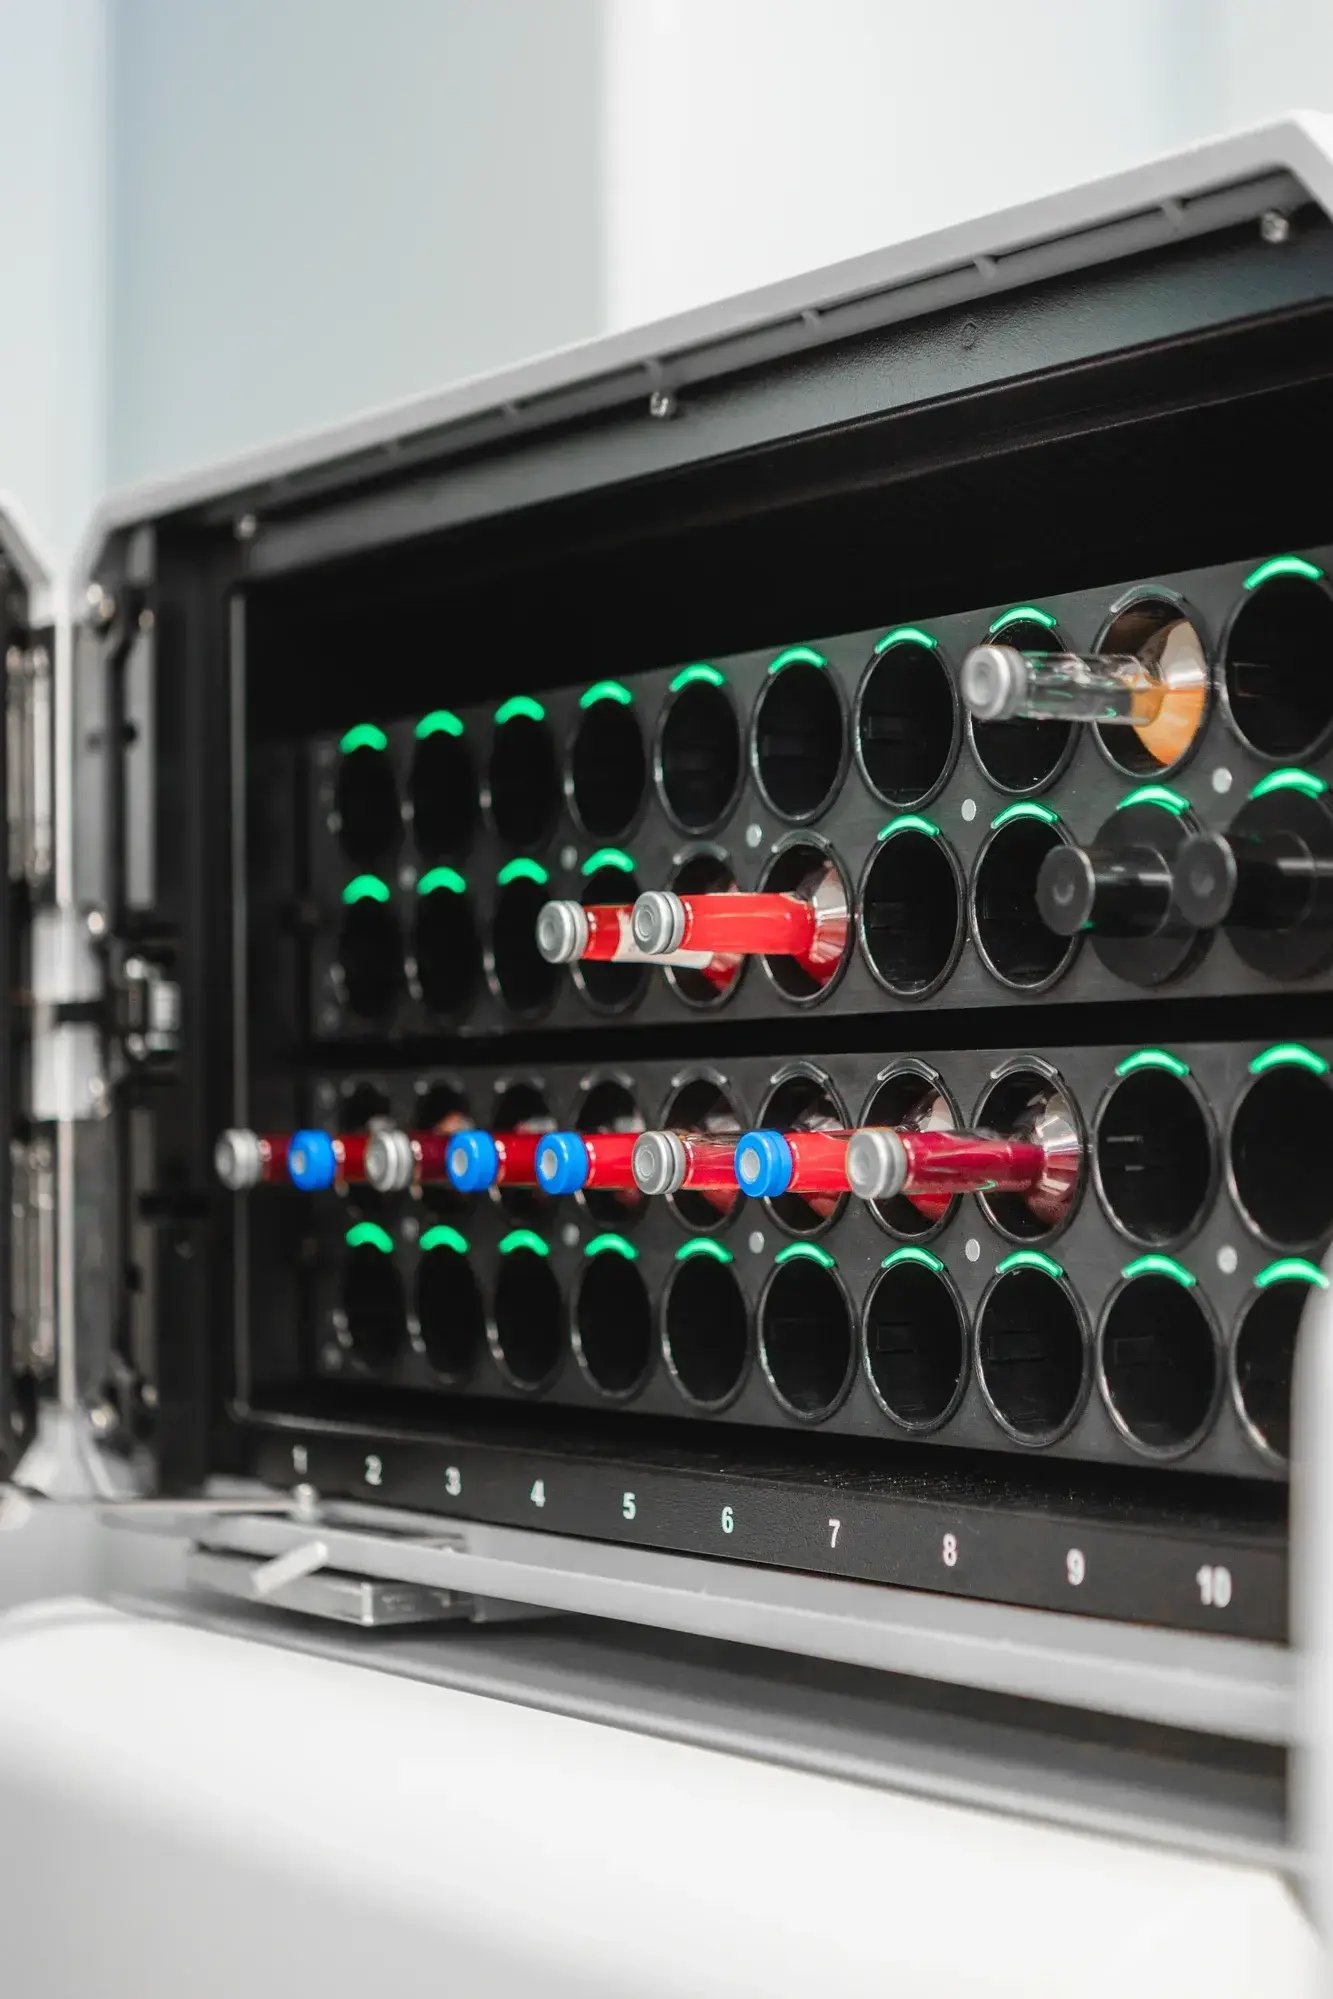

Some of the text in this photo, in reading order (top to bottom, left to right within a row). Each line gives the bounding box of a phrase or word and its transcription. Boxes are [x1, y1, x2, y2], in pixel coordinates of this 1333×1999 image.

[365, 1455, 383, 1486] 2
[445, 1466, 463, 1496] 3
[530, 1479, 546, 1508] 4
[622, 1492, 637, 1519] 5
[721, 1506, 735, 1534] 6
[828, 1518, 842, 1548] 7
[942, 1532, 958, 1567] 8
[1066, 1547, 1085, 1586] 9
[1196, 1564, 1233, 1608] 10
